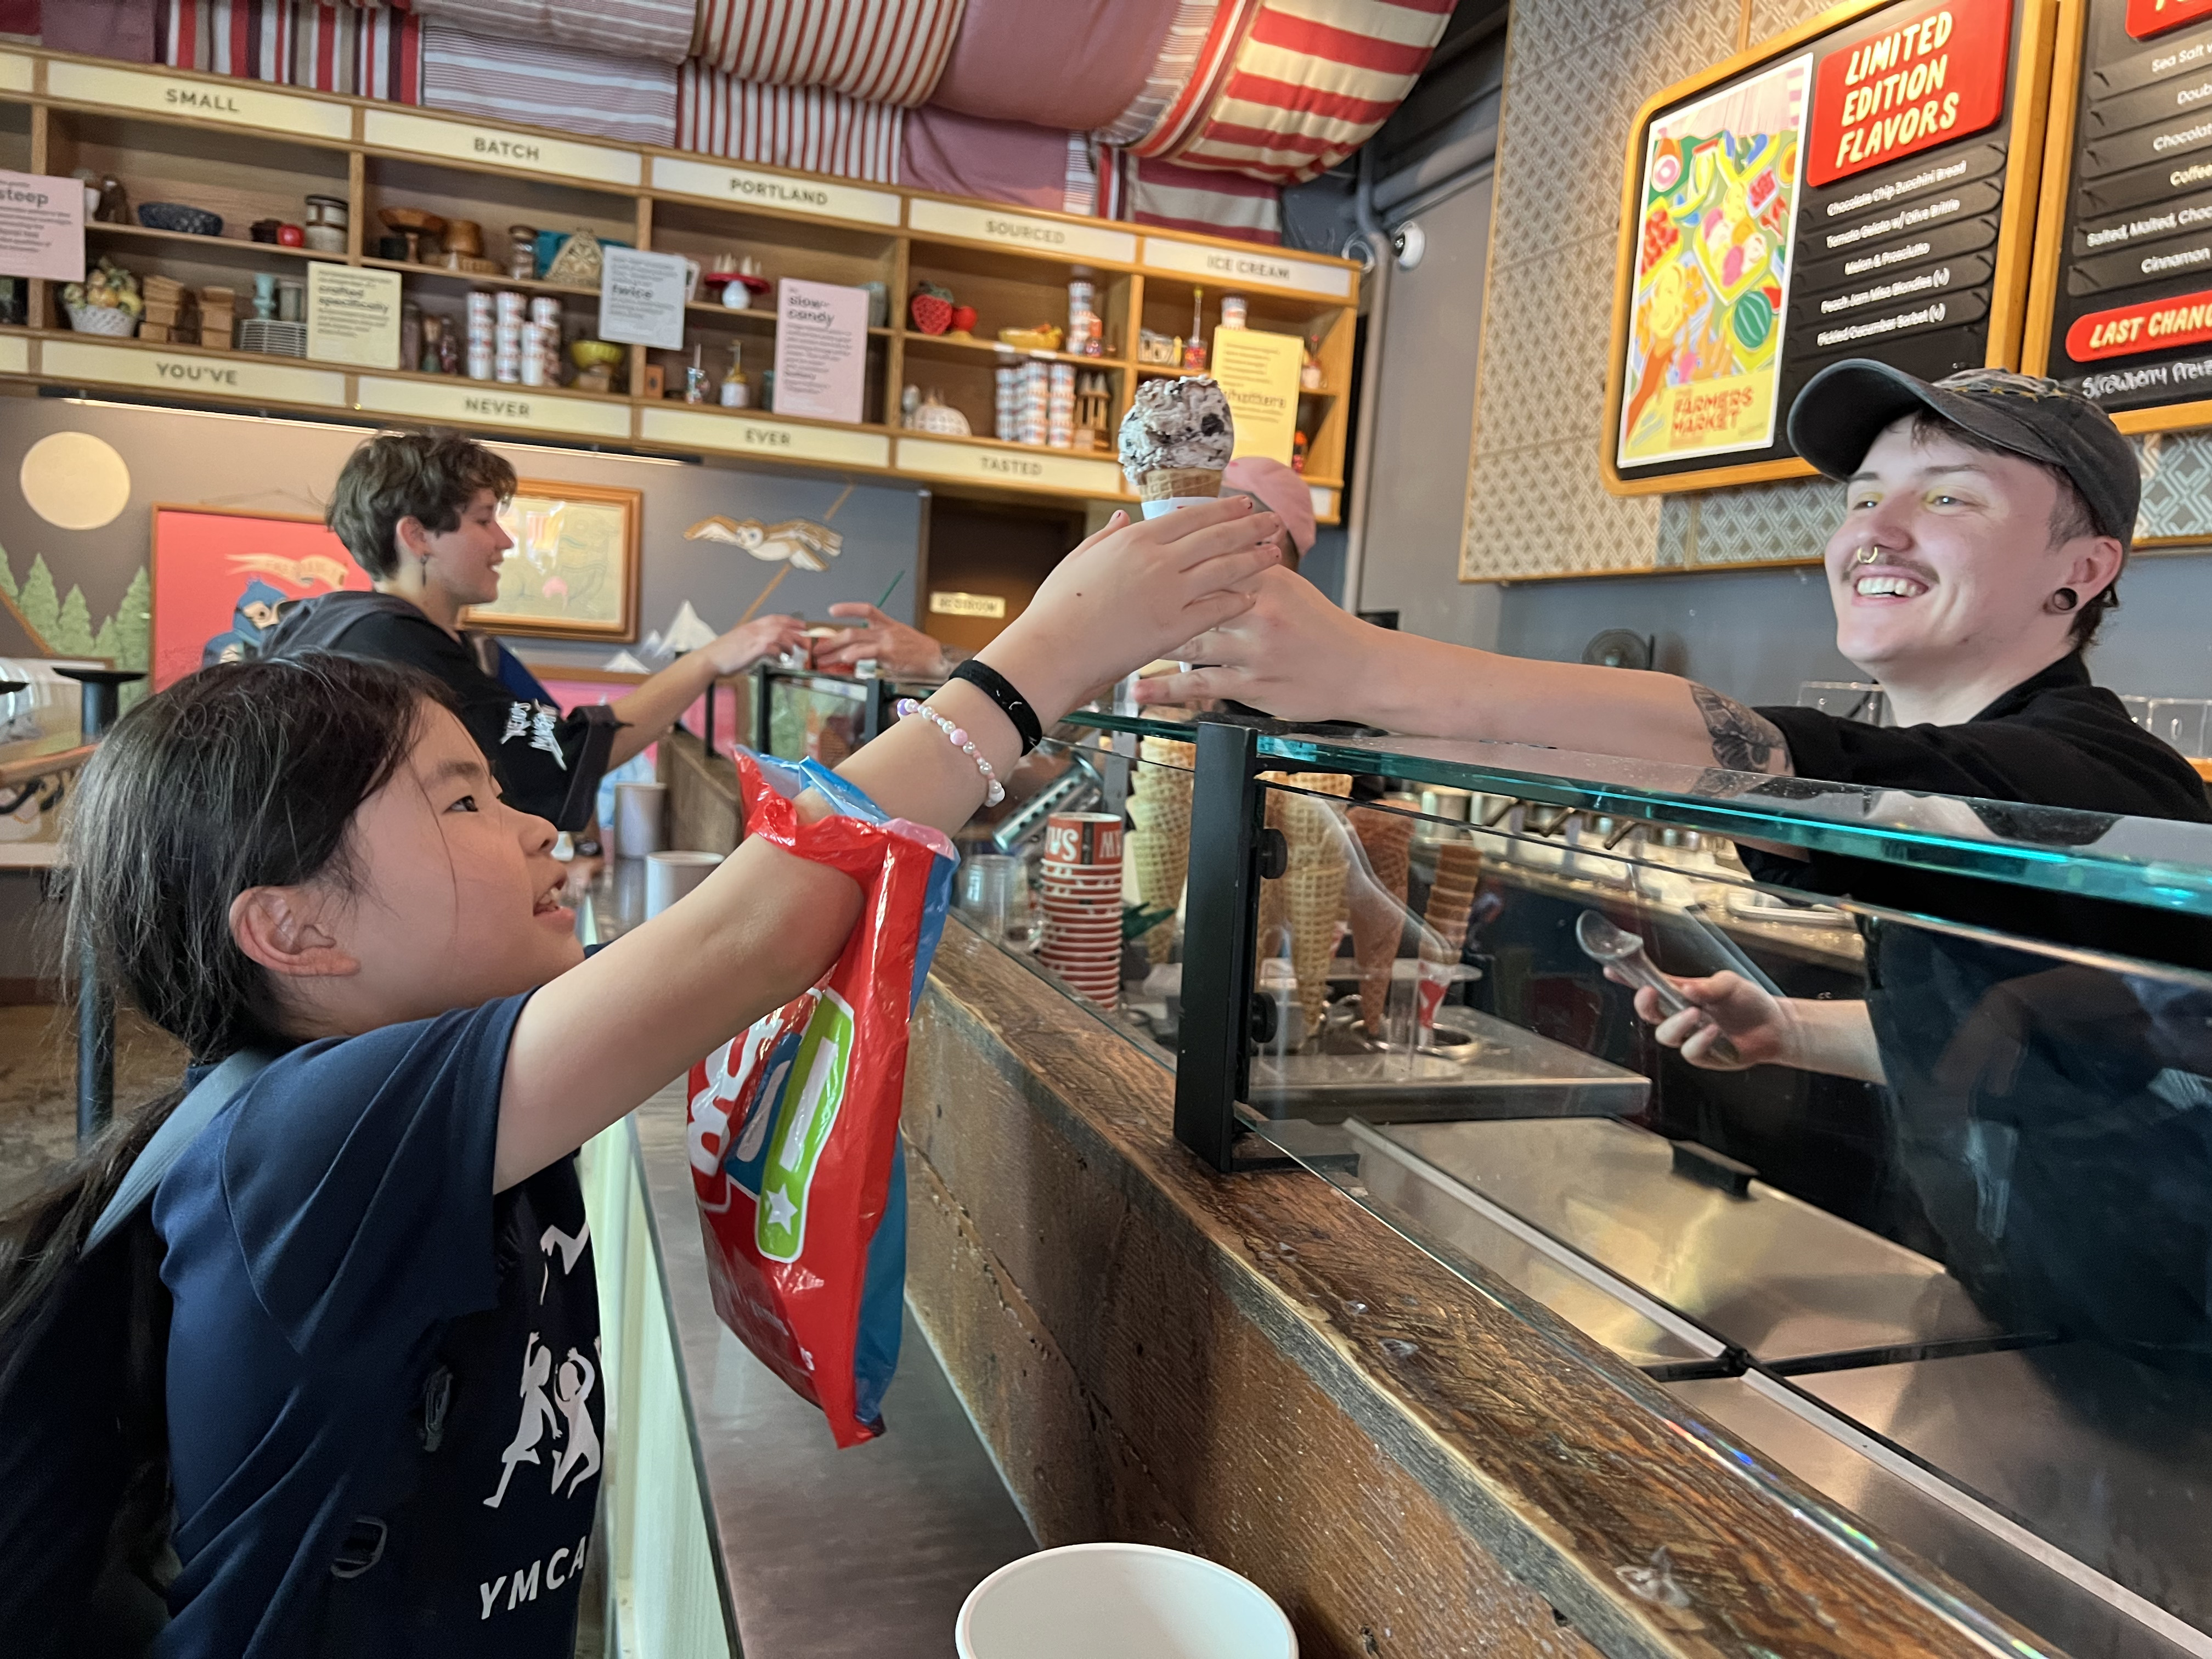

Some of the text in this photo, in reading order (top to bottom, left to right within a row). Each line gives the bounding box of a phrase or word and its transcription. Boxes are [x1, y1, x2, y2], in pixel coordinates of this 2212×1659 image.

[1845, 12, 1953, 86] LIMITED
[2152, 55, 2176, 72] Sea
[2179, 44, 2204, 63] Salt
[166, 88, 240, 111] SMALL
[1842, 54, 1948, 127] EDITION
[1836, 92, 1959, 168] FLAVORS
[475, 137, 539, 160] BATCH
[730, 178, 828, 205] PORTLAND
[1827, 193, 1872, 216] Chocolate
[1872, 185, 1894, 201] Chip
[986, 219, 1065, 244] SOURCED
[1207, 255, 1289, 280] ICE CREAM
[2141, 248, 2210, 273] Cinnamon
[2089, 317, 2146, 348] LAST
[156, 362, 238, 385] YOU'VE
[465, 396, 530, 418] NEVER
[746, 427, 791, 446] EVER
[981, 456, 1042, 475] TASTED
[480, 1536, 586, 1620] YMCA
